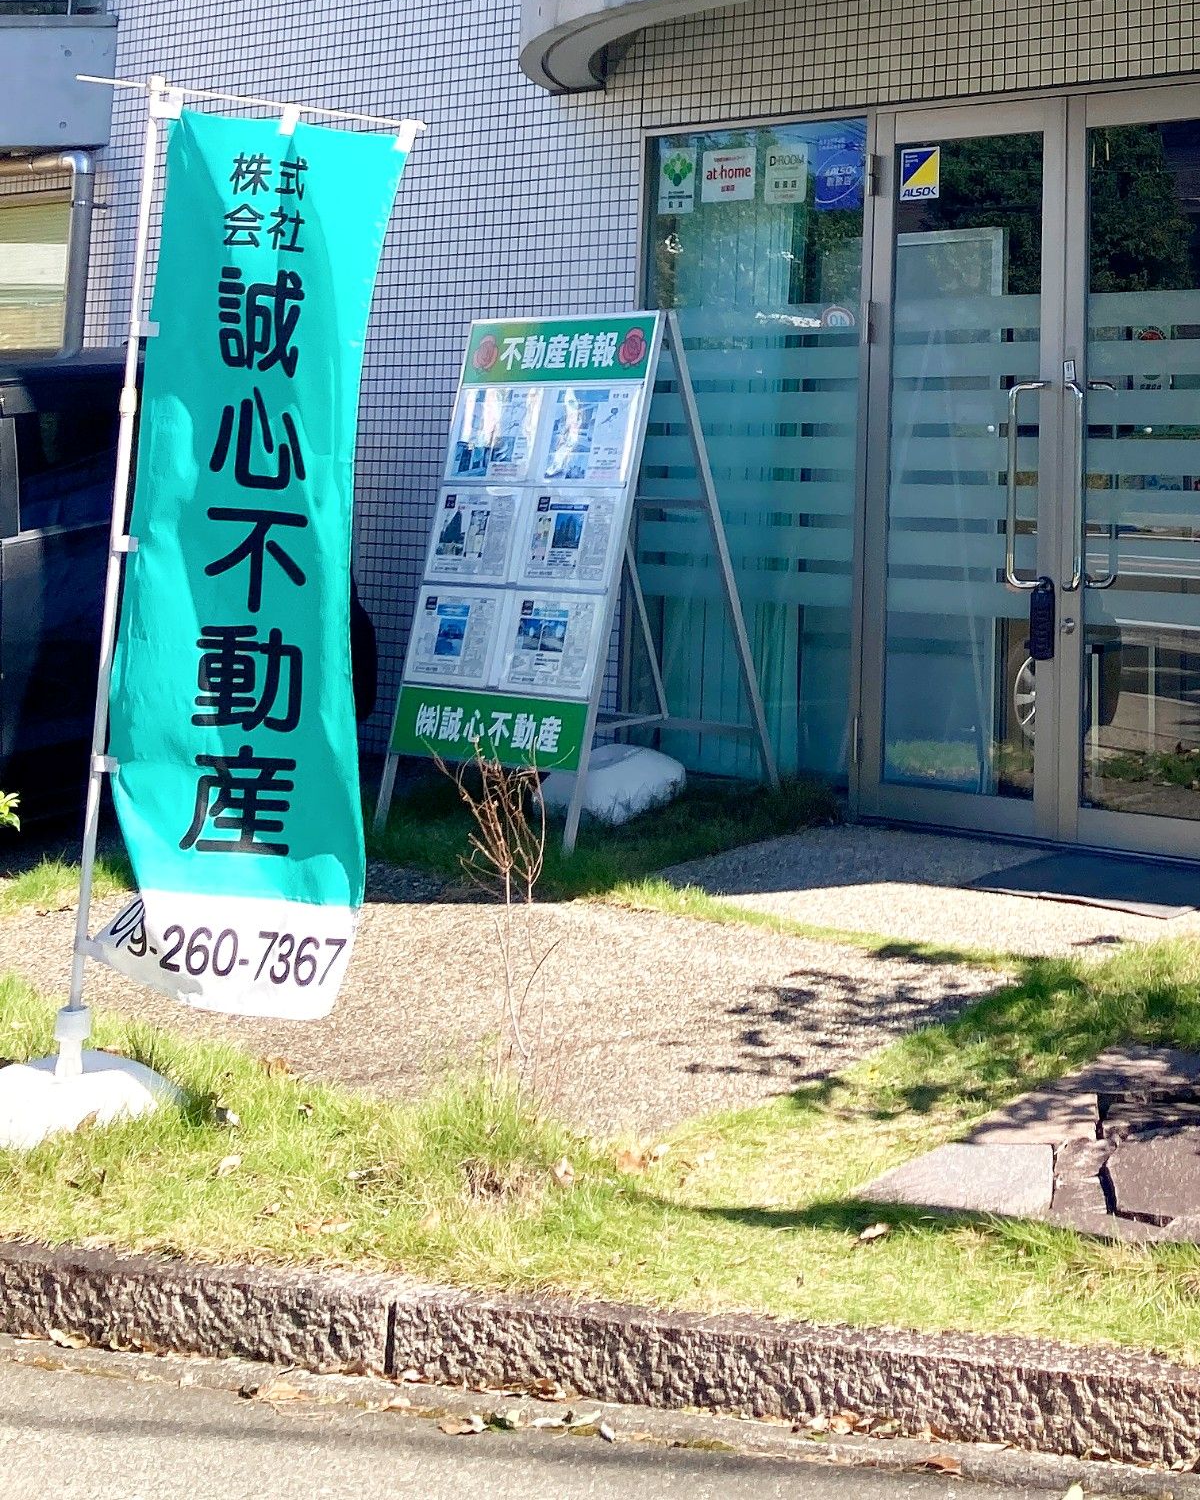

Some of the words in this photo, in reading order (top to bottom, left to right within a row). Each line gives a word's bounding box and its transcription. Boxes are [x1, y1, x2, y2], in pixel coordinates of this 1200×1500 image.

[903, 186, 936, 198] ALSOK
[500, 331, 618, 370] 不動産情報
[179, 266, 308, 858] 誠心不動産
